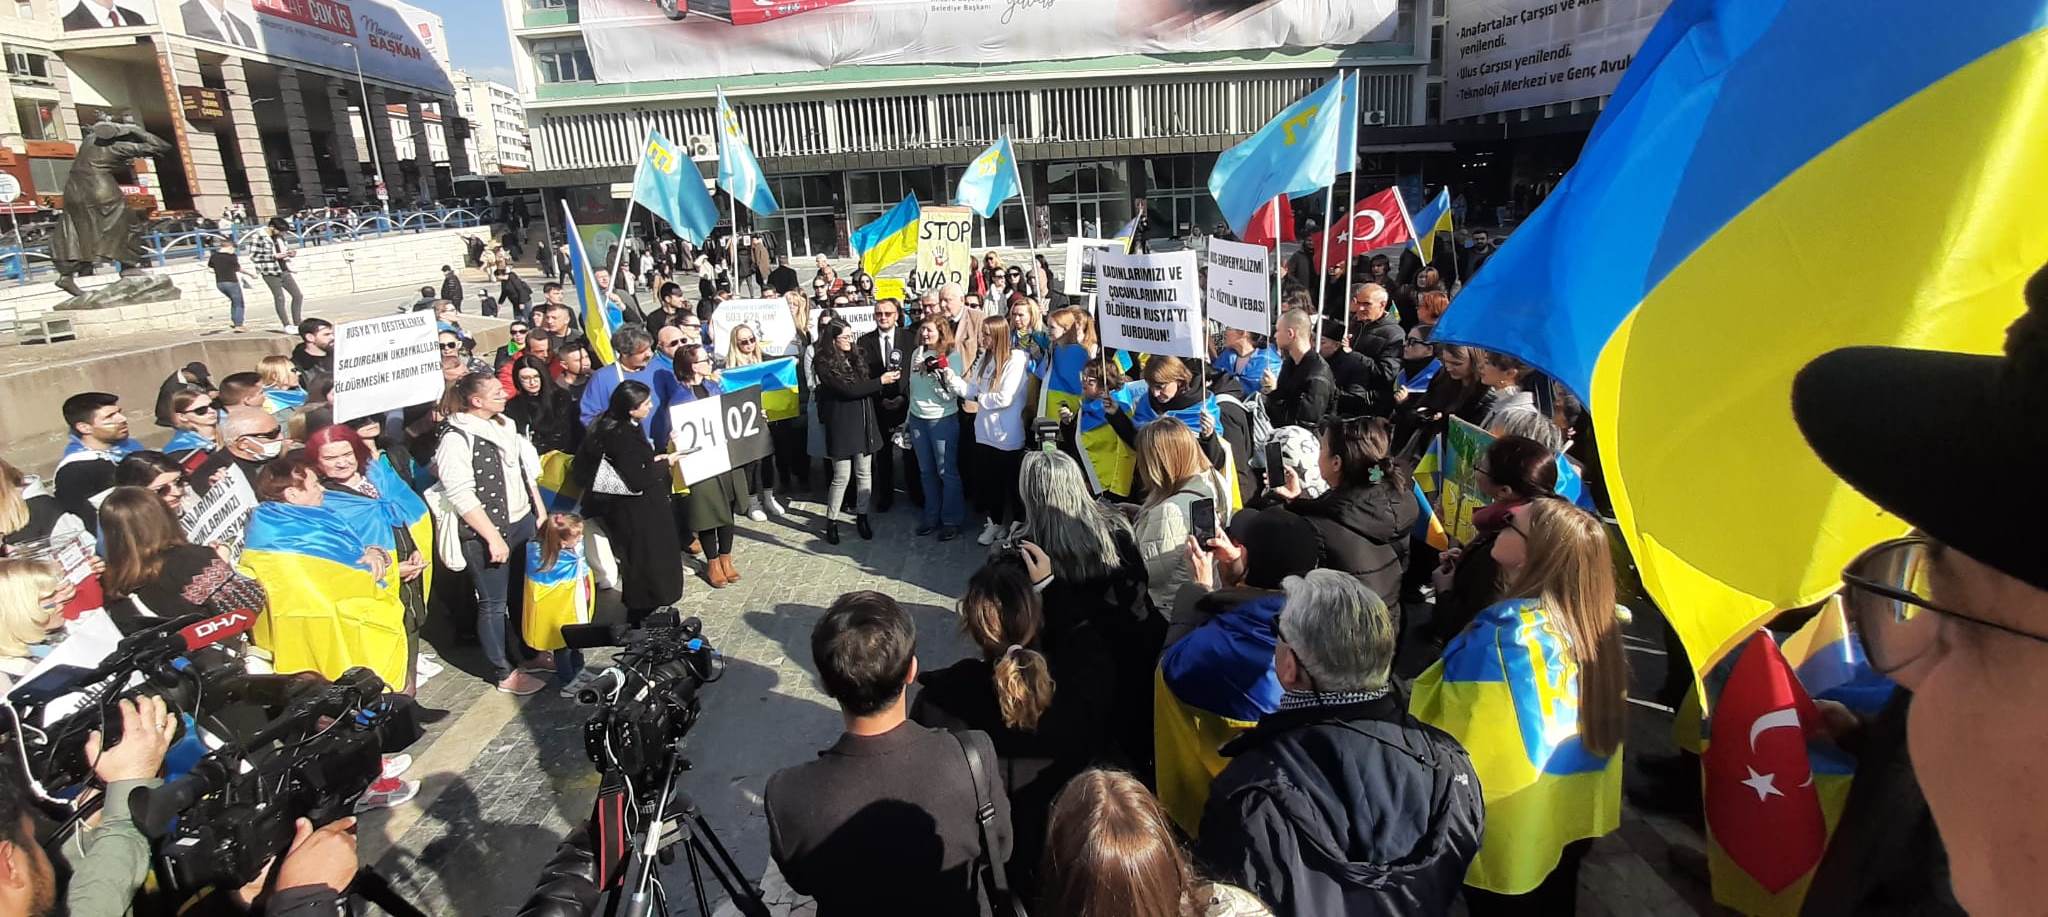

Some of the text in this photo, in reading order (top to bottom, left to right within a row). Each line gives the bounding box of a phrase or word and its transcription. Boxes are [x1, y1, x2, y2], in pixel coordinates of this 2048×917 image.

[308, 0, 337, 25] ÇOK
[335, 5, 351, 33] İŞ
[1460, 0, 1575, 38] Anafartalar Çarşısı ve
[368, 34, 422, 60] BAŞKAN
[1460, 34, 1507, 59] yenilendi.
[1460, 43, 1572, 79] Ulus Çarşısı yenilendi.
[1460, 82, 1500, 100] Teknoloji
[1502, 72, 1547, 92] Merkezi
[1550, 72, 1564, 84] ve
[1567, 65, 1597, 78] Genç
[920, 221, 971, 242] STOP
[1102, 265, 1183, 282] KADINLARIMIZI VE
[1218, 253, 1264, 275] EMPERYALİZMİ
[917, 270, 962, 290] WAR
[1109, 285, 1177, 302] ÇOCUKLARIMIZI
[1216, 288, 1238, 308] YÜZYILIN
[1239, 297, 1266, 313] VEBASI
[1105, 300, 1187, 322] ÖLDÜREN RUSYA'YI
[381, 316, 426, 333] DESTEKLEMEK
[1121, 324, 1170, 342] DURDURUN!
[338, 352, 388, 370] SALDIRGANIN
[335, 371, 389, 394] ÖLDÜRMESİNE
[392, 366, 419, 381] YARDIM
[681, 401, 760, 456] 24 02
[225, 475, 236, 489] VE
